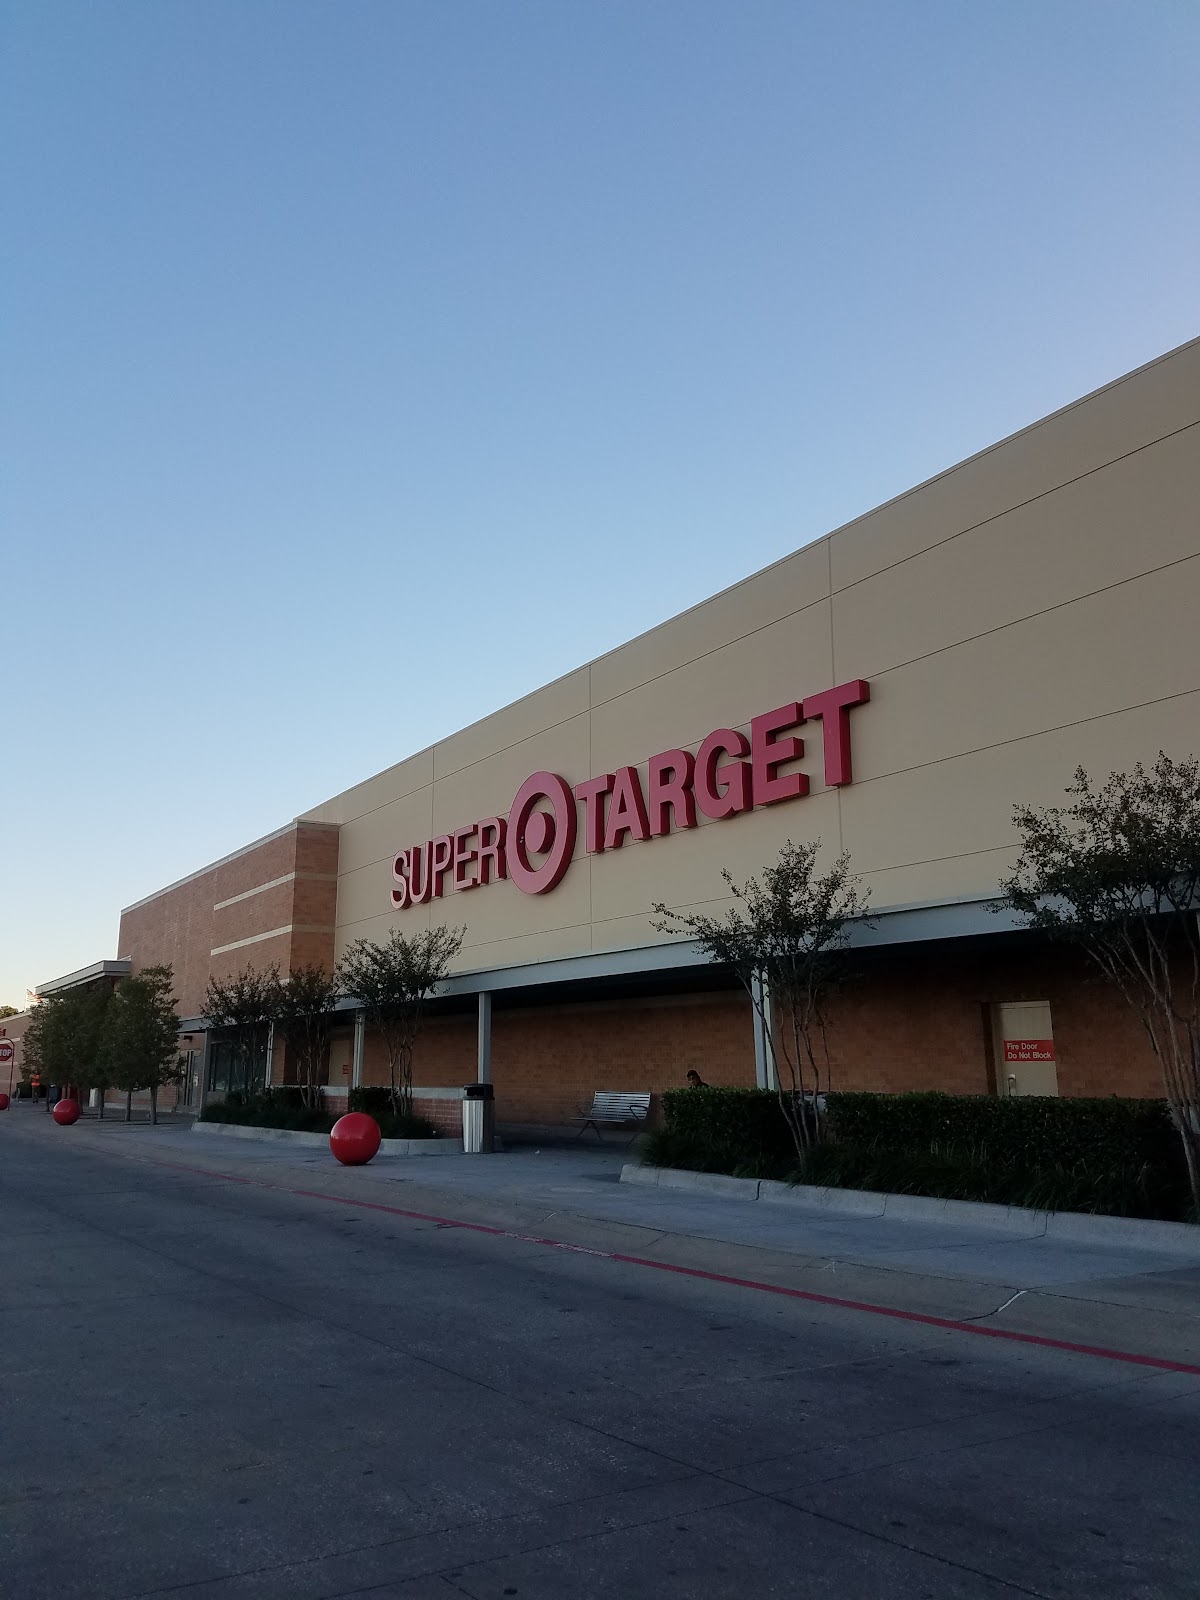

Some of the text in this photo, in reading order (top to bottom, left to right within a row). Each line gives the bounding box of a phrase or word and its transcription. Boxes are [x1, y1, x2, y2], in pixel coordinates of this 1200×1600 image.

[390, 679, 870, 909] SUPER TARGET
[0, 1049, 12, 1057] TOP
